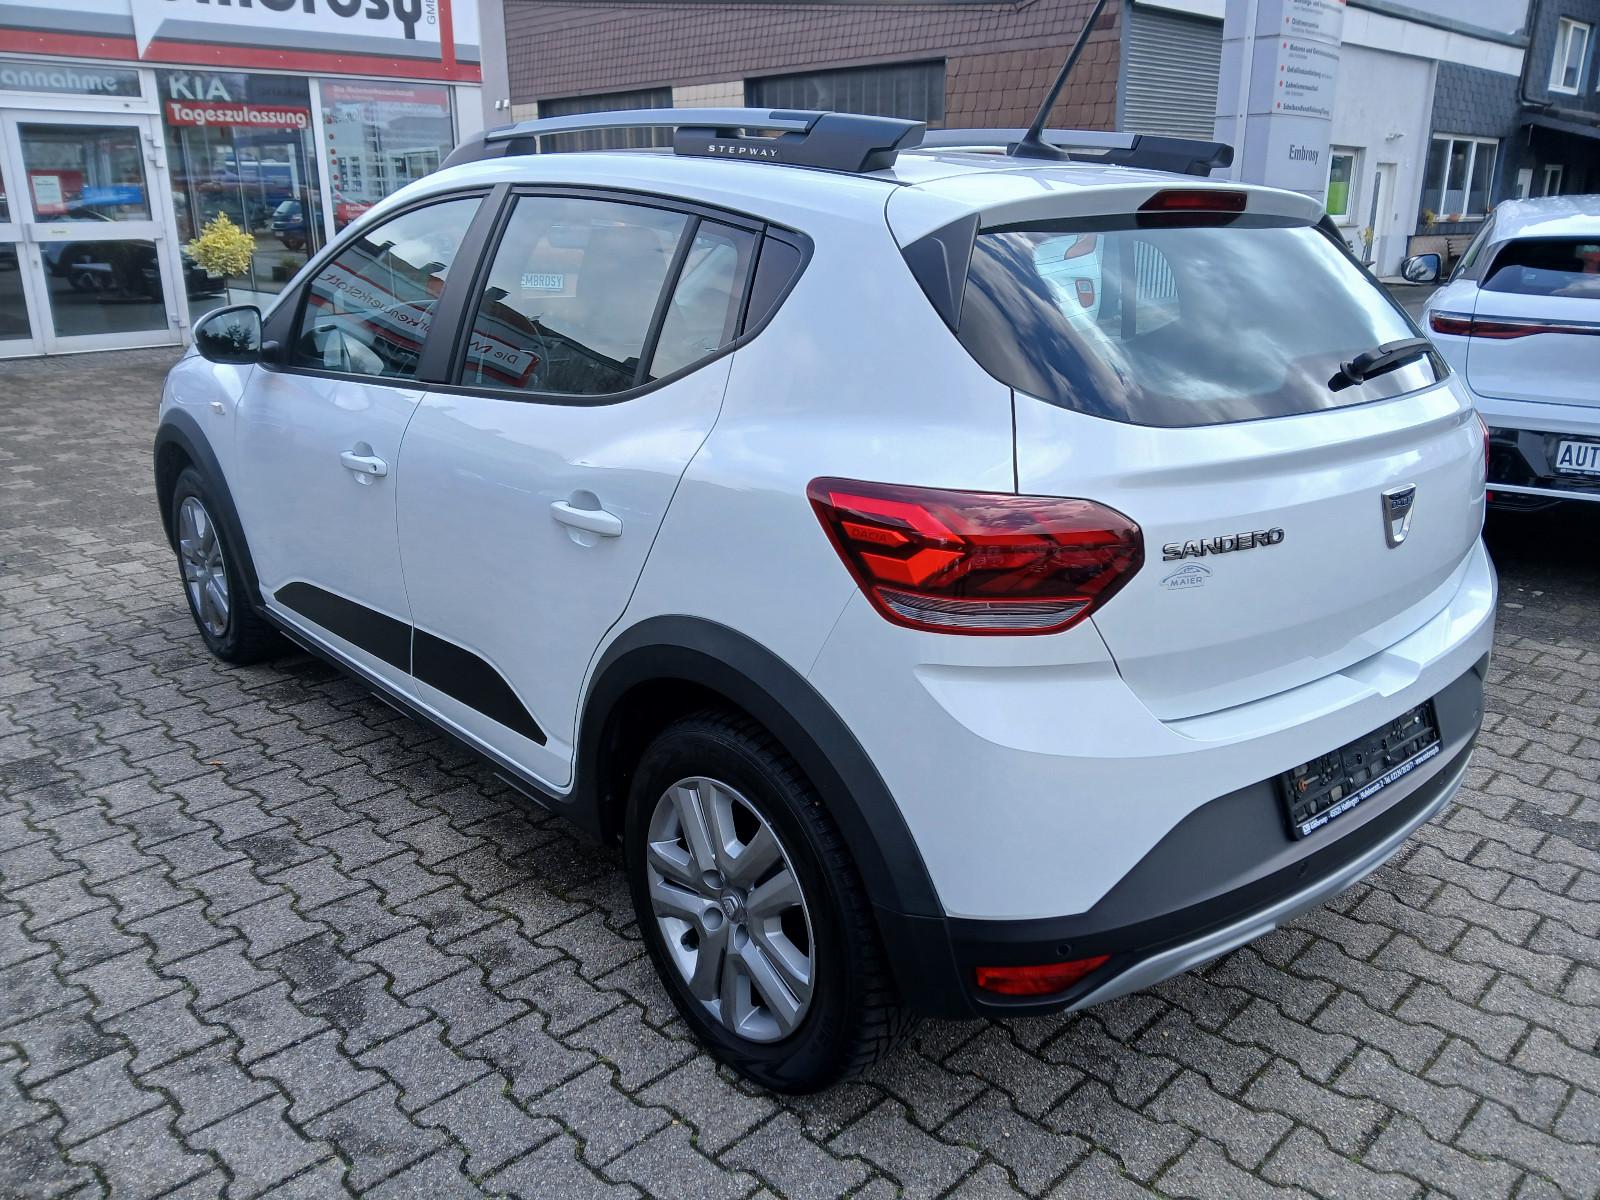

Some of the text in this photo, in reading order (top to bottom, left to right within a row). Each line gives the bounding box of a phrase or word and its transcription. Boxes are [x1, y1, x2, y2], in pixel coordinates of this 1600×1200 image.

[169, 75, 232, 101] KIA
[170, 103, 307, 129] Tageszulassung
[708, 144, 778, 157] STEPWAY
[1289, 144, 1320, 165] Embrosy
[1559, 444, 1600, 468] AUT
[851, 526, 888, 543] DACIA
[1162, 527, 1285, 562] SANDERO
[1170, 576, 1203, 587] MAIER
